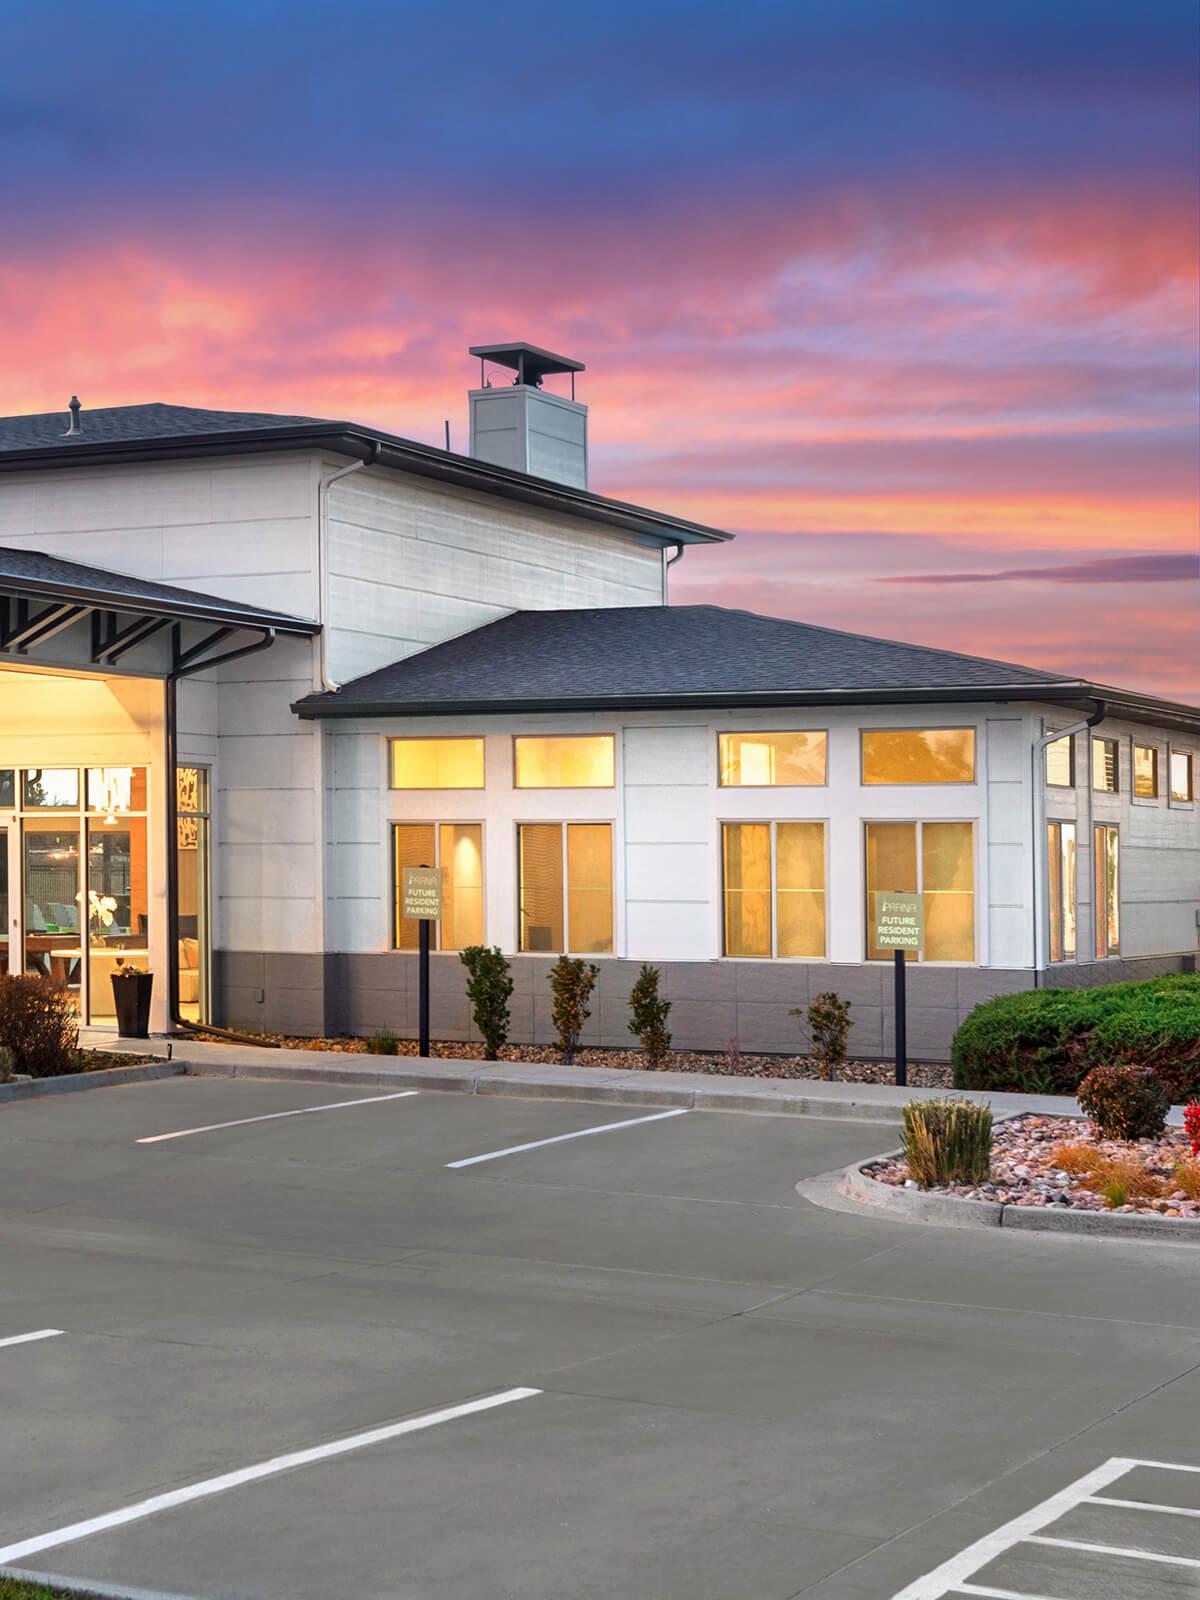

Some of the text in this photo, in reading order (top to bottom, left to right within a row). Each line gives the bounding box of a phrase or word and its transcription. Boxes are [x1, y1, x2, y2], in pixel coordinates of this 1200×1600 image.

[408, 889, 437, 897] FUTURE
[405, 897, 439, 906] RESIDENT
[406, 906, 438, 915] PARKING
[882, 916, 916, 925] FUTURE
[878, 926, 920, 935] RESIDENT
[880, 936, 918, 945] PARKING
